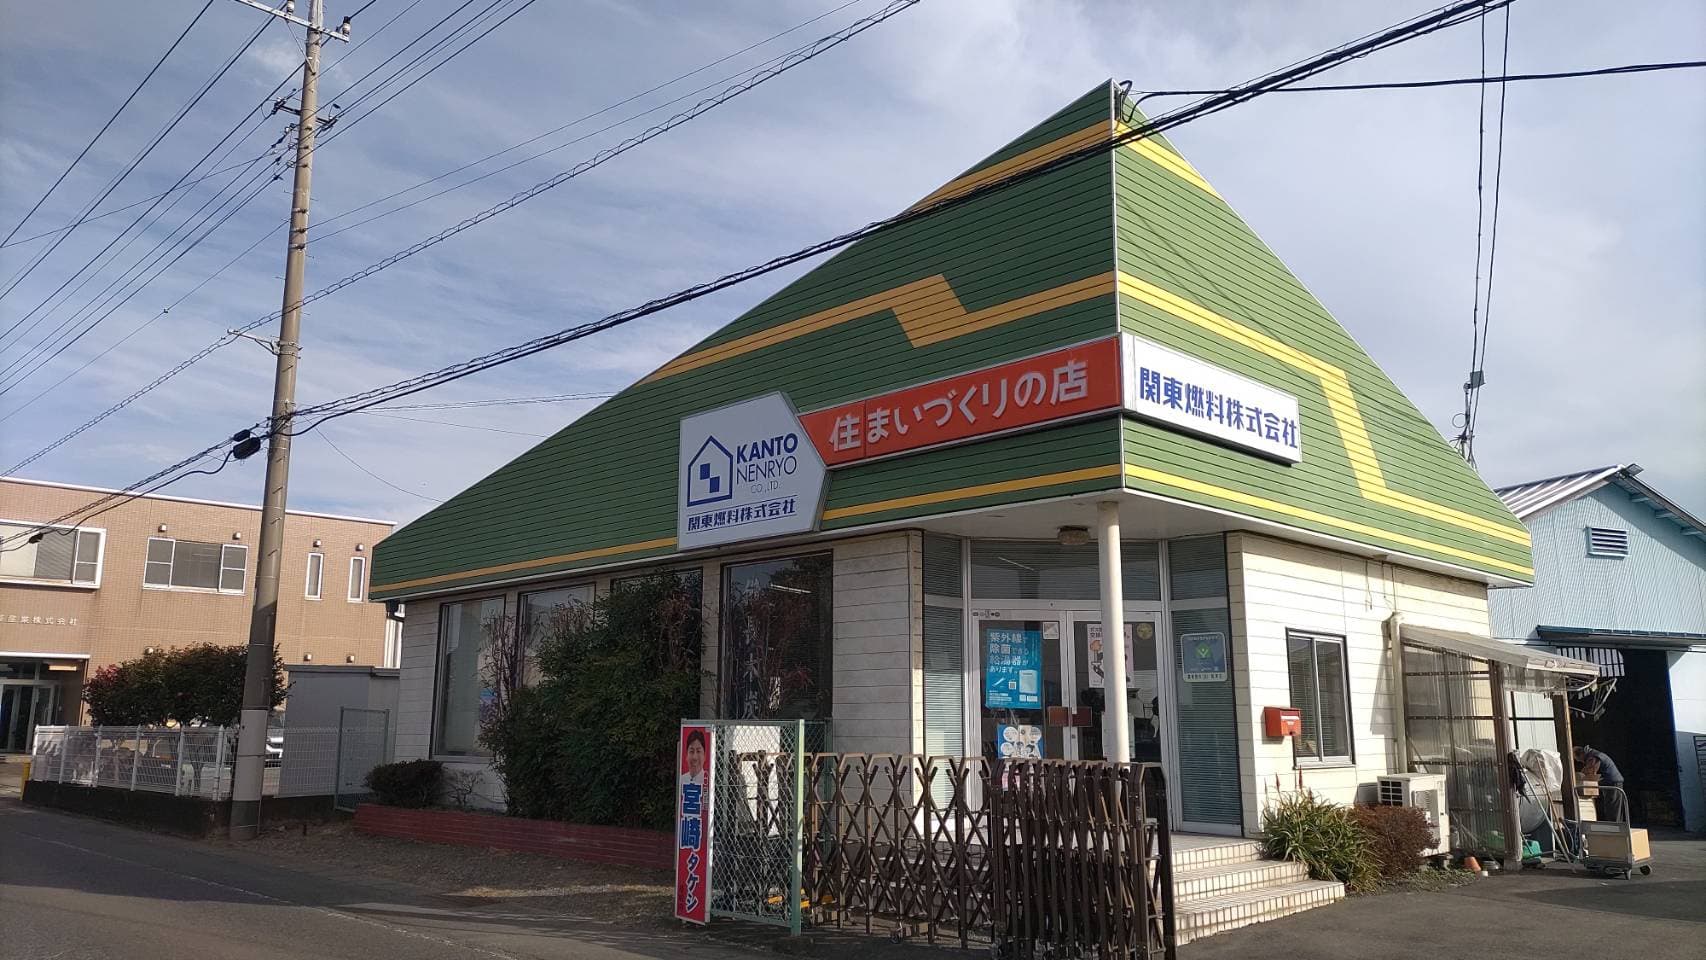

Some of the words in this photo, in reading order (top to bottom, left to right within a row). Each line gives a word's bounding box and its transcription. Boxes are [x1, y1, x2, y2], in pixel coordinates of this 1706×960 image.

[828, 359, 1089, 452] 住まいづくりの店
[1139, 366, 1298, 449] 関東燃料株式会社
[736, 433, 798, 464] KANTO
[736, 456, 797, 485] NENRYO
[688, 498, 796, 531] 関東燃料株式会社
[681, 783, 702, 912] 宮崎タケシ
